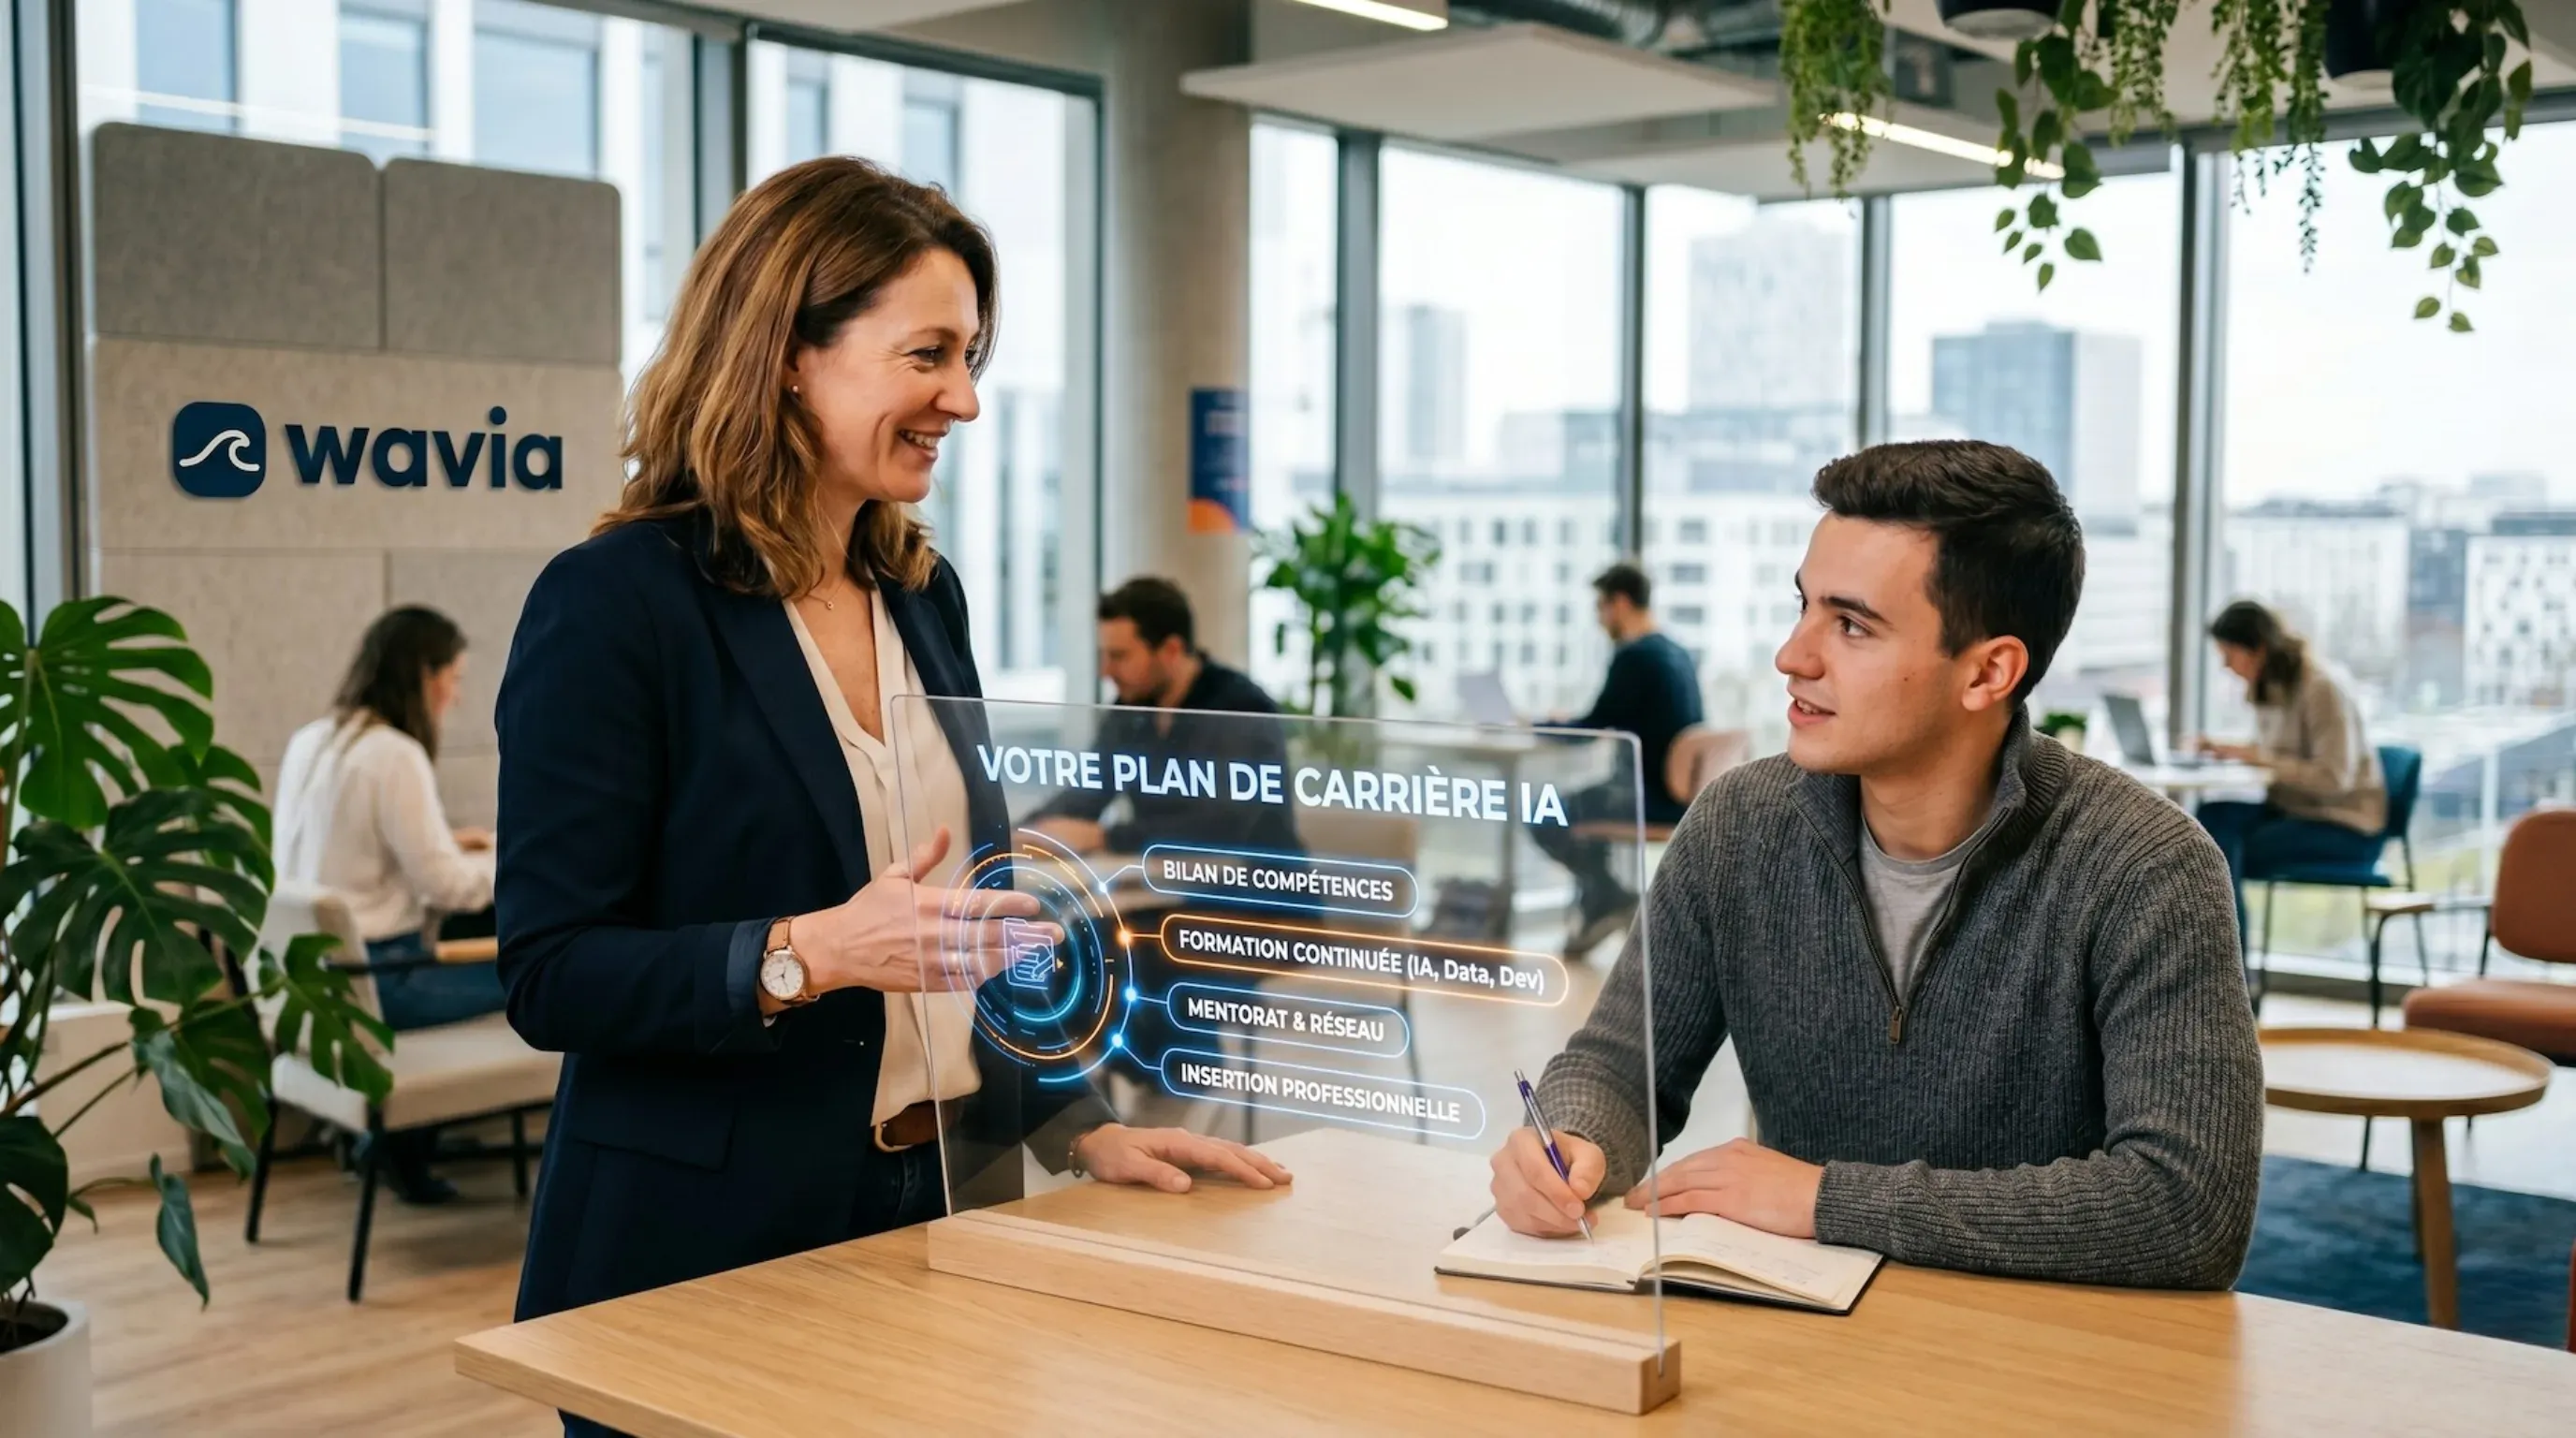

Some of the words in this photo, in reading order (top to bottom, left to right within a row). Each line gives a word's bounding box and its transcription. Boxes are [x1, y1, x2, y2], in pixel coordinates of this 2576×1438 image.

[285, 405, 564, 491] wavia
[976, 744, 1104, 789] VOTRE
[1112, 754, 1217, 799] PLAN
[1228, 761, 1284, 804] DE
[1294, 764, 1508, 822] CARRIÈRE
[1520, 781, 1570, 827] IA
[1163, 859, 1218, 884] BILAN
[1222, 866, 1249, 888] DE
[1251, 869, 1394, 902] COMPÉTENCES
[1178, 929, 1289, 961] FORMATION
[1293, 942, 1403, 974] CONTINUÉE
[1407, 954, 1440, 982] (IA,
[1443, 959, 1495, 989] Data,
[1500, 966, 1544, 996] Dev)
[1187, 997, 1288, 1029] MENTORAT
[1293, 1011, 1306, 1032] &
[1310, 1011, 1384, 1042] RÉSEAU
[1180, 1063, 1278, 1095] INSERTION
[1281, 1079, 1461, 1123] PROFESSIONNELLE
